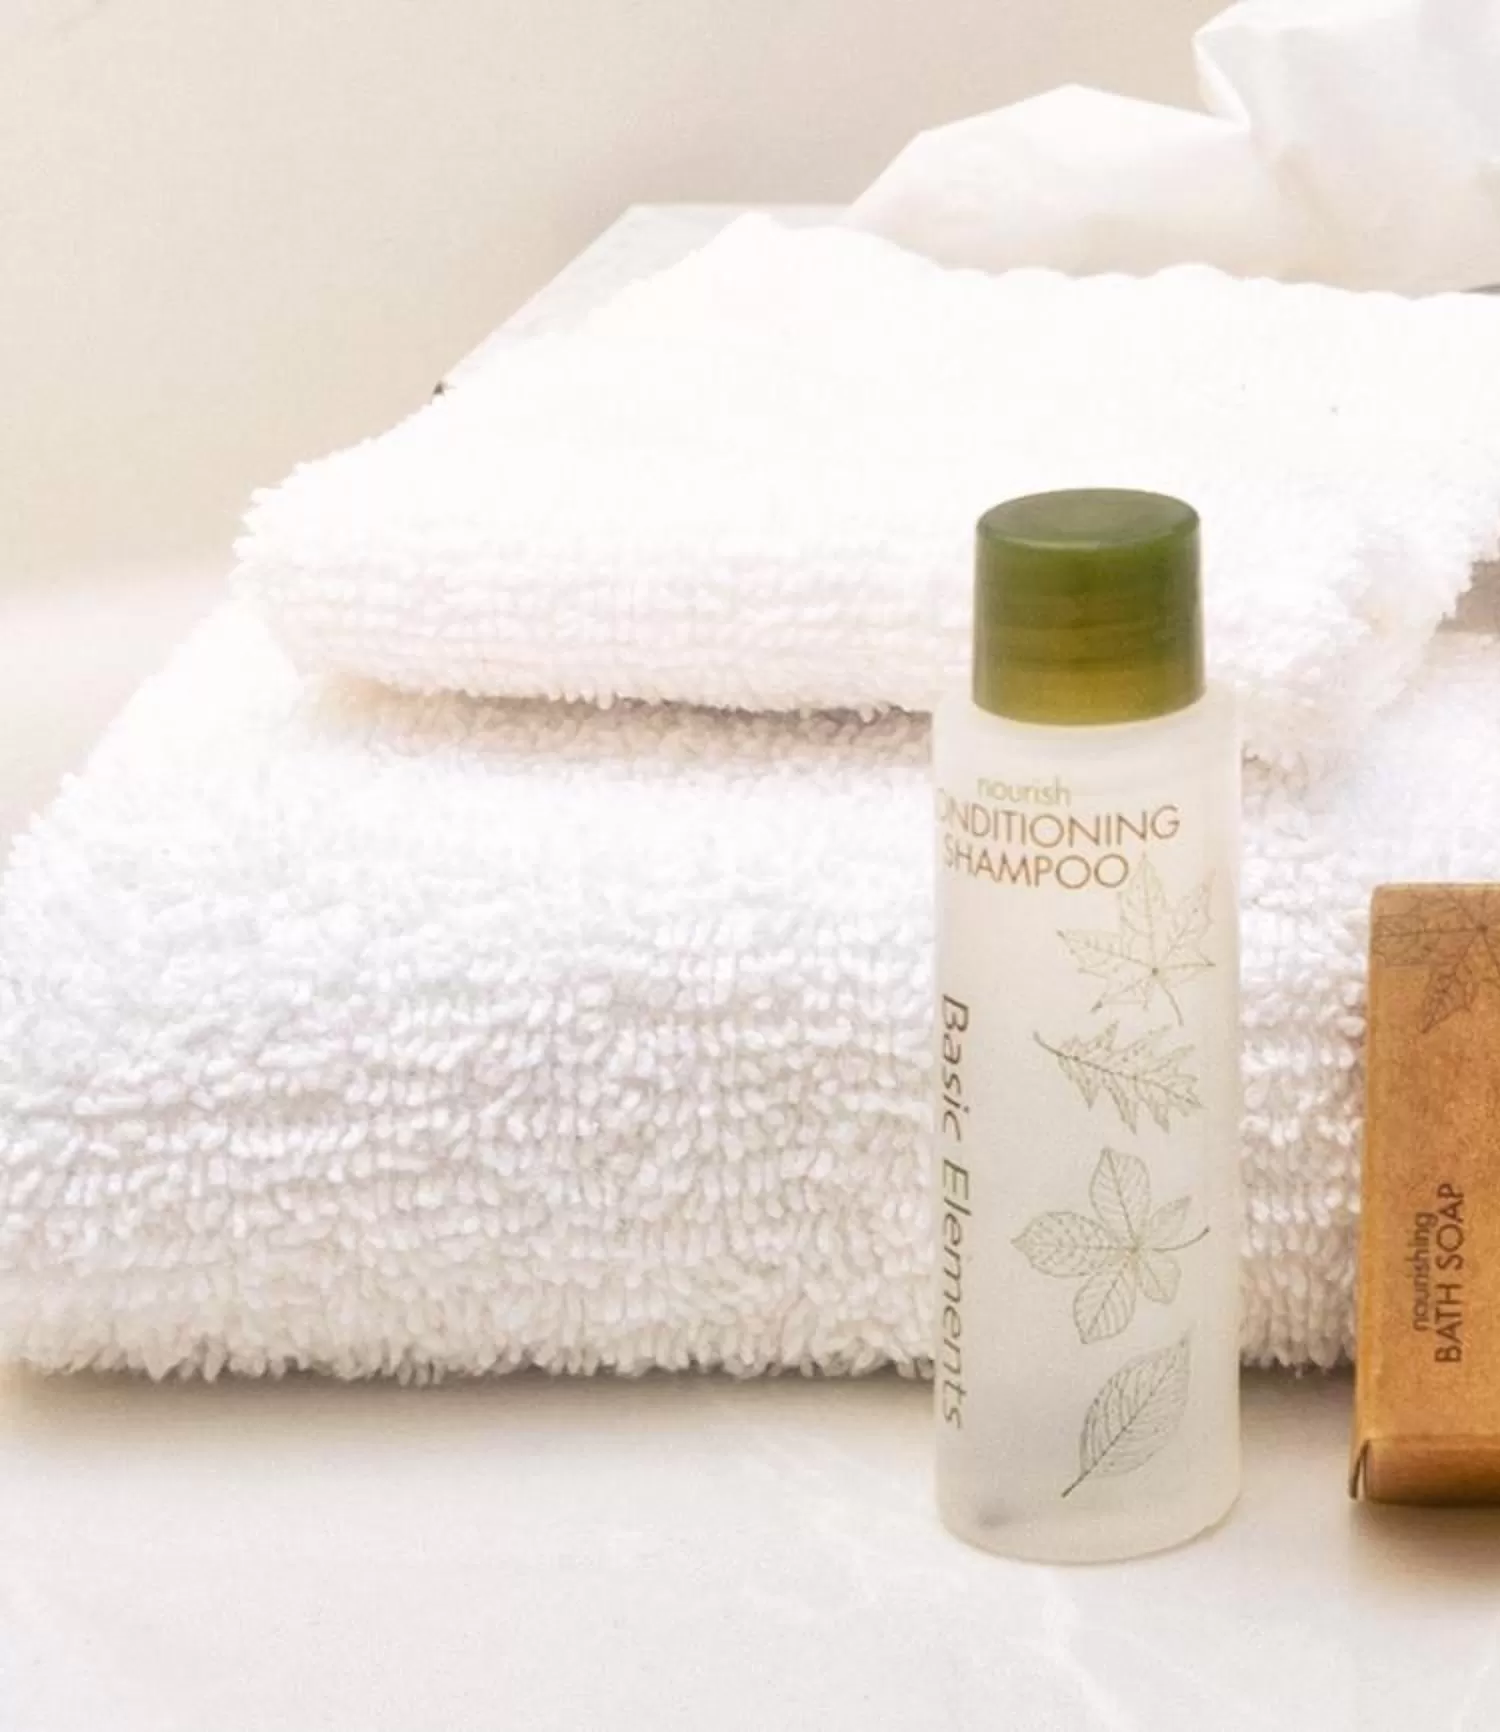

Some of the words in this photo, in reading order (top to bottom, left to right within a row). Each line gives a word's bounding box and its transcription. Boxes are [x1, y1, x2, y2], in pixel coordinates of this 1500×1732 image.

[938, 788, 1180, 848] ONDITIONING
[977, 775, 1071, 807] nourish
[944, 833, 1129, 889] SHAMPOO
[942, 994, 971, 1142] Basic
[1436, 1183, 1465, 1271] SOAP
[942, 1158, 972, 1429] Elements
[1404, 1211, 1438, 1331] nourishing
[1434, 1284, 1464, 1363] BATH
